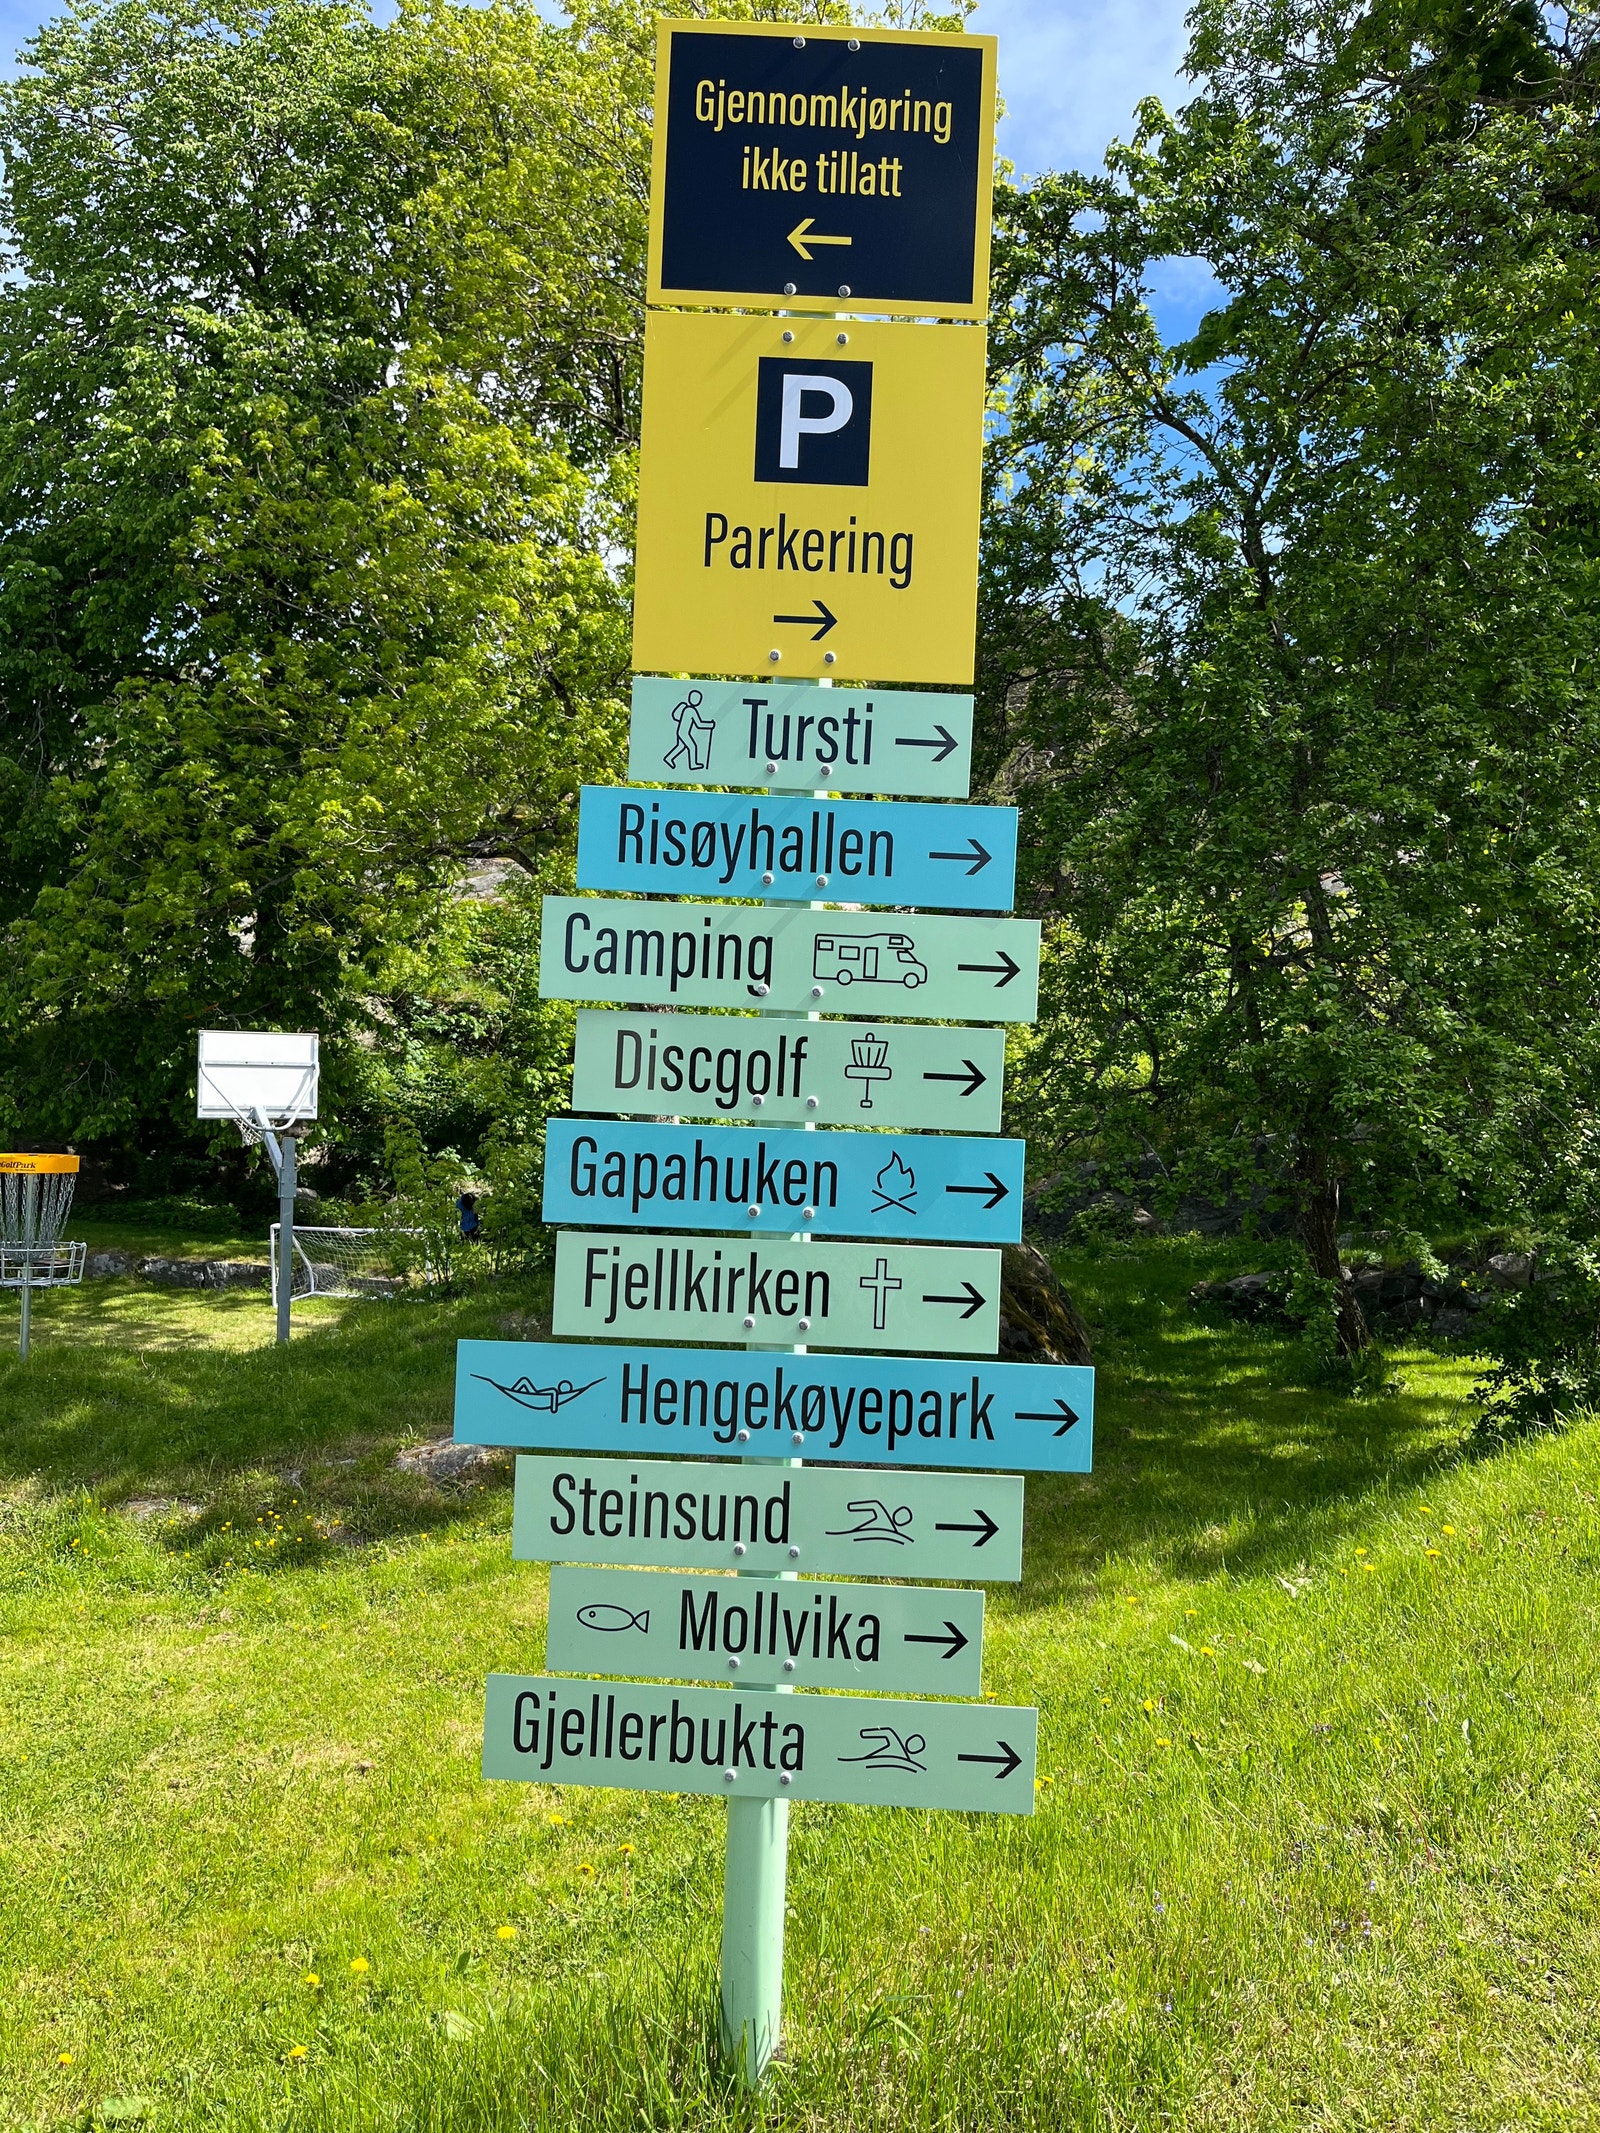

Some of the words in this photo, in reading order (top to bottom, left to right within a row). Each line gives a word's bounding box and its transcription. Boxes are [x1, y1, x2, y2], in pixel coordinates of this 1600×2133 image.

[695, 79, 952, 144] Gjennomkjøring
[742, 146, 807, 192] ikke
[816, 151, 903, 197] tillatt
[779, 373, 854, 469] P
[704, 512, 914, 590] Parkering
[743, 699, 874, 764] Tursti
[618, 802, 894, 884] Risøyhallen
[565, 912, 773, 997] Camping
[615, 1029, 808, 1110] Discgolf
[571, 1135, 838, 1214] Gapahuken
[584, 1246, 830, 1323] Fjellkirken
[620, 1362, 995, 1450] Hengekøyepark
[550, 1472, 791, 1545] Steinsund
[680, 1589, 881, 1662] Mollvika
[513, 1690, 805, 1771] Gjellerbukta
